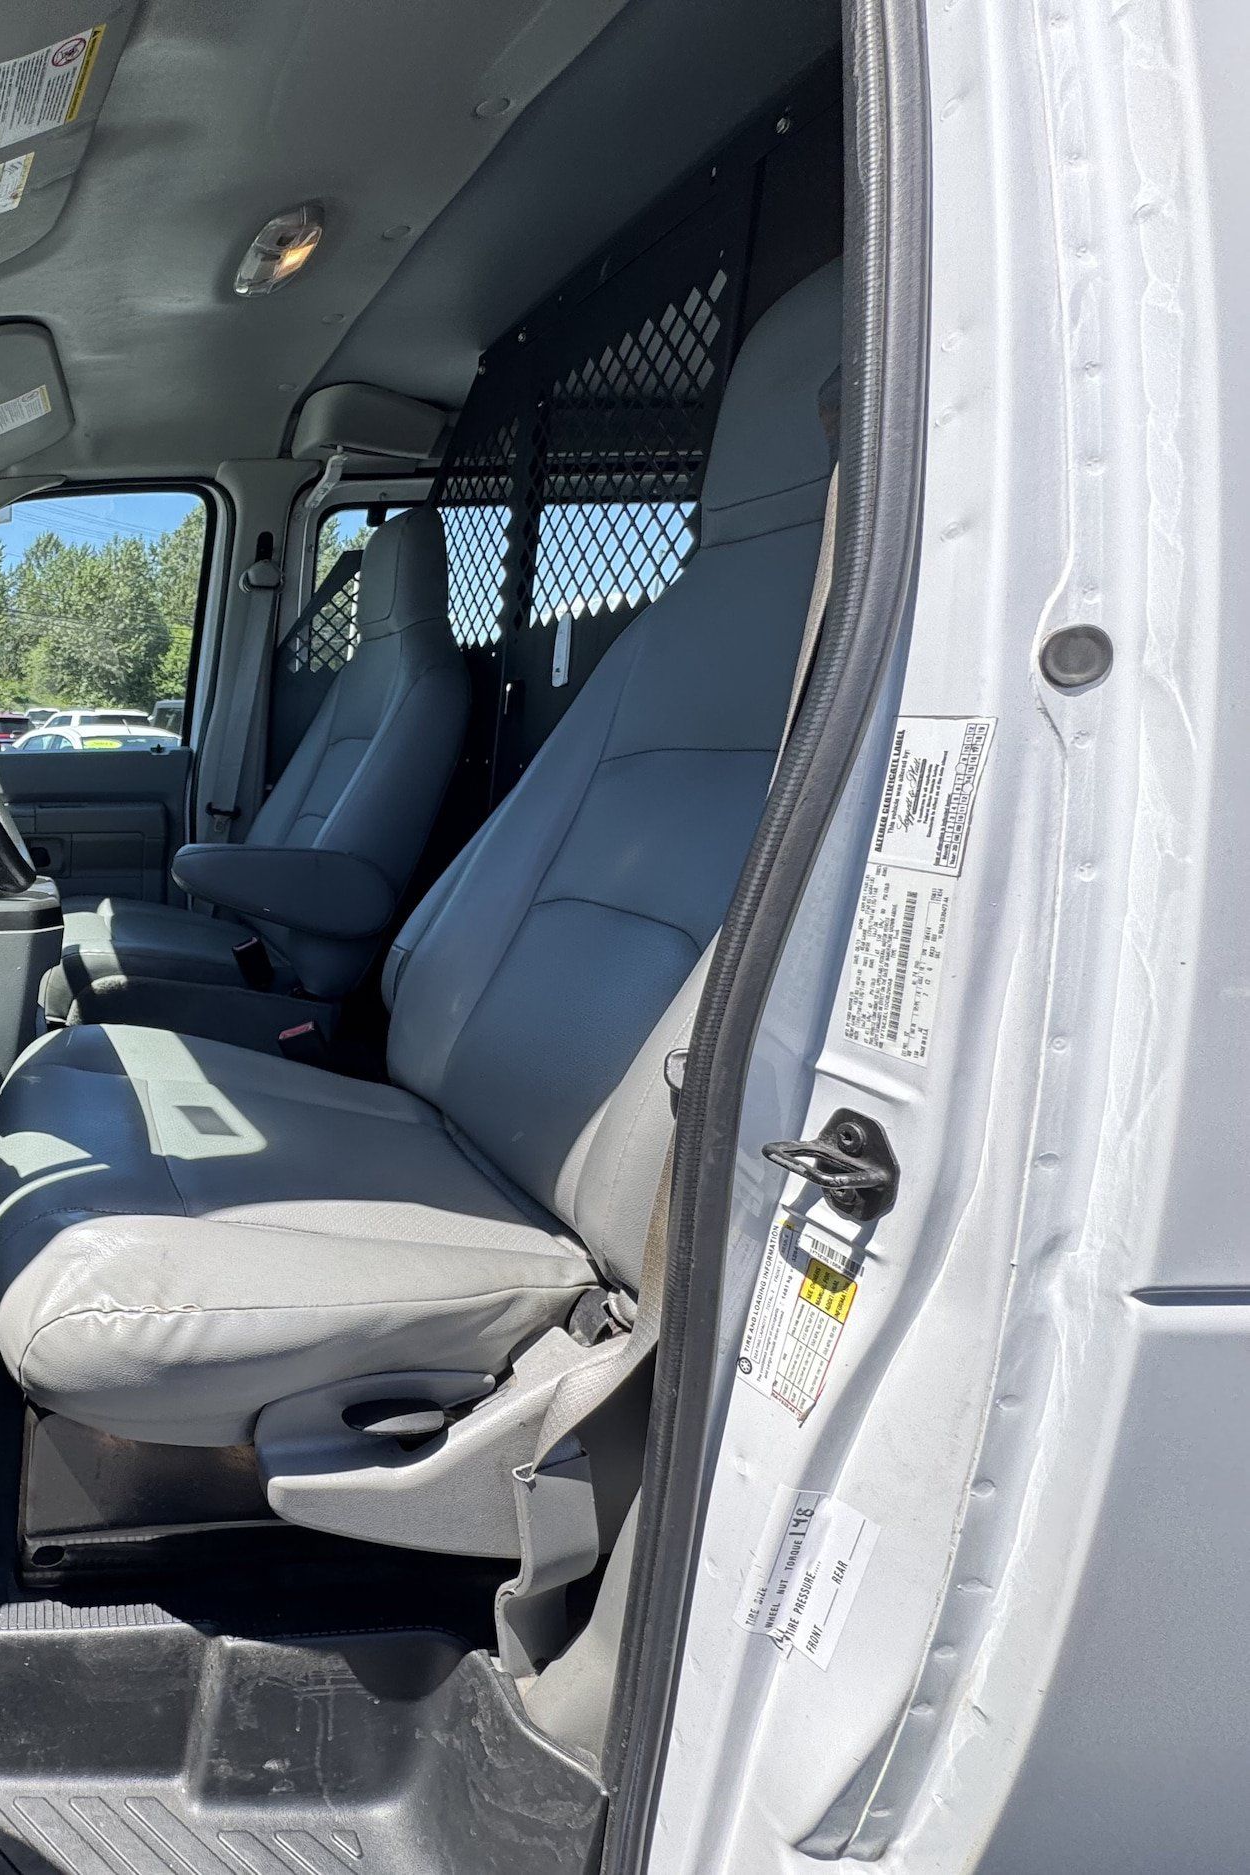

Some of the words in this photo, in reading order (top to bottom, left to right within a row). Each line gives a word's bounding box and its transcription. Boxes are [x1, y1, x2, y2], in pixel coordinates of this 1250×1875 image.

[874, 816, 888, 852] ALTERED
[882, 758, 900, 814] CERTIFICATE
[893, 730, 906, 757] LABEL
[887, 821, 895, 834] This
[891, 798, 900, 820] vehicle
[898, 760, 907, 782] altered
[744, 1335, 752, 1352] TIRE
[749, 1317, 757, 1333] AND
[753, 1281, 766, 1315] LOADING
[763, 1225, 779, 1279] INFORMATION
[745, 1608, 760, 1627] TIRE
[764, 1603, 781, 1628] WHEEL
[776, 1579, 788, 1595] NUT
[784, 1540, 803, 1571] TORQUE
[784, 1617, 799, 1636] TIRE
[806, 1624, 823, 1654] FRONT
[831, 1560, 848, 1585] REAR
